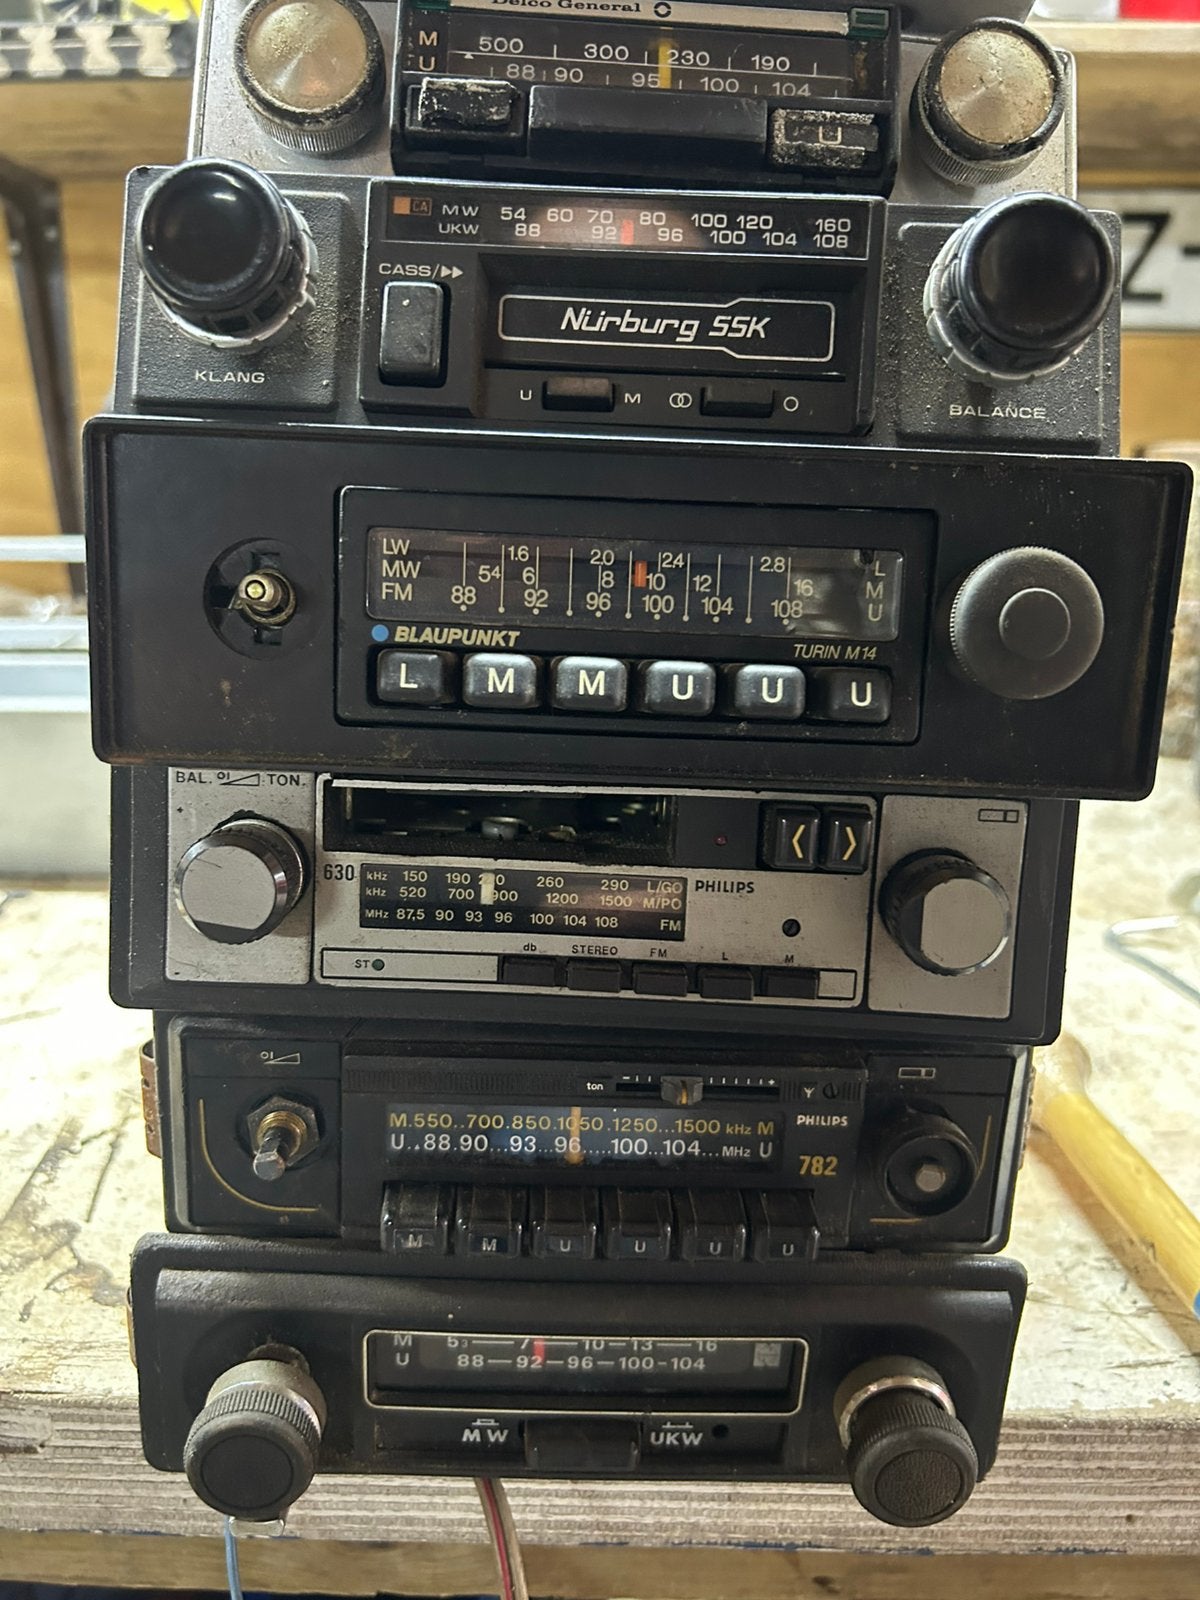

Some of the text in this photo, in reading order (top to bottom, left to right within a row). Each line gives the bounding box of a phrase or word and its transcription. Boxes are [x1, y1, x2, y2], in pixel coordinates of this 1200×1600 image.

[558, 0, 641, 12] General
[419, 31, 790, 72] M 500 300 230 190
[419, 56, 811, 97] U 88 90 95 100 104
[819, 126, 842, 144] U
[442, 205, 850, 233] MW 54 60 70 80 100 120 160
[439, 223, 848, 248] UKW 88 92 96 100 104 108
[560, 306, 772, 343] Nürburg SSK
[194, 370, 265, 384] KLANG
[520, 390, 641, 404] U M
[949, 404, 1046, 419] BALANCE
[382, 538, 410, 556] LW
[760, 556, 786, 573] 2.8
[874, 560, 886, 576] L
[382, 560, 814, 596] MW 54 6 8 10 12 16
[866, 581, 883, 599] M
[382, 582, 803, 618] FM 88 92 96 100 104 108
[868, 604, 883, 622] U
[394, 626, 520, 647] BLAUPUNKT
[793, 644, 840, 659] TURIN
[400, 663, 872, 707] L M M U U U
[176, 771, 306, 786] BAL. TON.
[324, 864, 354, 880] 630
[366, 872, 388, 881] kHz
[402, 870, 428, 882] 150
[446, 872, 470, 884] 190
[536, 876, 564, 888] 260
[601, 879, 629, 892] 290
[647, 880, 683, 894] L/GO
[695, 880, 754, 894] PHILIPS
[366, 887, 386, 896] kHz
[400, 886, 426, 898] 520
[448, 888, 474, 900] 700
[546, 892, 578, 905] 1200
[599, 894, 632, 908] 1500
[642, 898, 682, 911] M/PO
[365, 908, 682, 932] MHz 87,5 90 93 96 100 104 108 FM
[523, 943, 794, 964] db STEREO FM L M
[354, 960, 370, 969] ST
[586, 1082, 604, 1091] ton
[726, 1122, 752, 1135] kHz
[758, 1122, 774, 1136] M
[796, 1114, 848, 1126] PHILIPS
[722, 1146, 750, 1158] MHz
[759, 1142, 774, 1158] U
[800, 1155, 838, 1176] 782
[482, 1238, 496, 1252] M
[560, 1240, 571, 1252] U
[634, 1240, 646, 1253] U
[710, 1242, 722, 1255] U
[782, 1244, 794, 1256] U
[394, 1334, 412, 1347] M
[582, 1340, 604, 1350] 10
[396, 1352, 706, 1370] U 88 92 96 100 104
[462, 1428, 702, 1445] MW UKW
